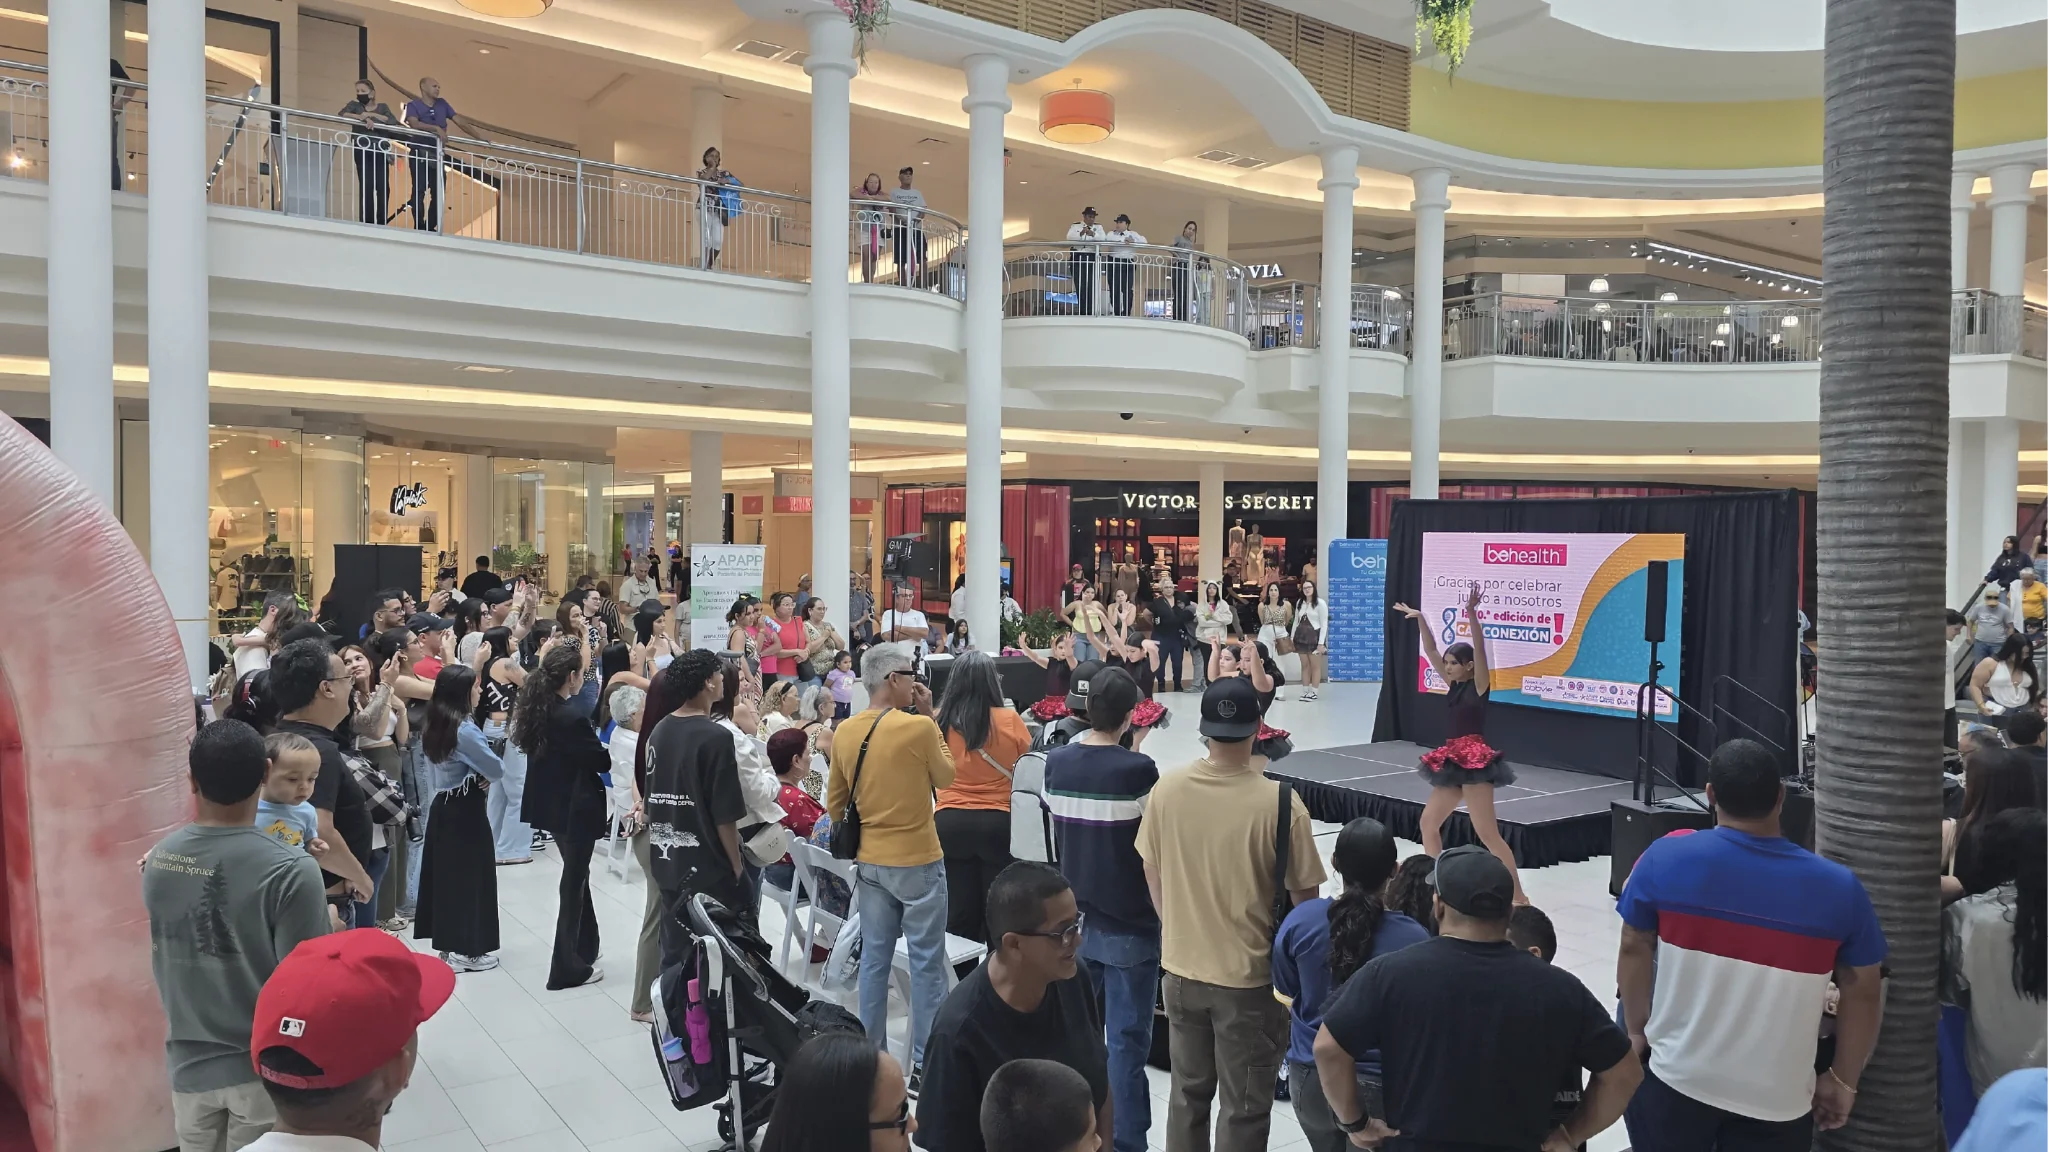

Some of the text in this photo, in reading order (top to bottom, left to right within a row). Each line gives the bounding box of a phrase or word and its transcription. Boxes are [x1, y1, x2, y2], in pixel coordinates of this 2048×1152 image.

[1123, 493, 1315, 511] VICTORS SECRET
[717, 554, 763, 567] APAPP
[1351, 551, 1387, 569] beh
[1487, 545, 1560, 563] behealth
[1484, 579, 1504, 592] por
[1508, 578, 1562, 592] celebrar
[1494, 595, 1500, 605] a
[1504, 595, 1562, 607] nosotros
[1493, 611, 1534, 624] edición
[1537, 613, 1551, 624] de
[1482, 626, 1549, 642] CONEXIÓN
[185, 864, 215, 877] Spruce
